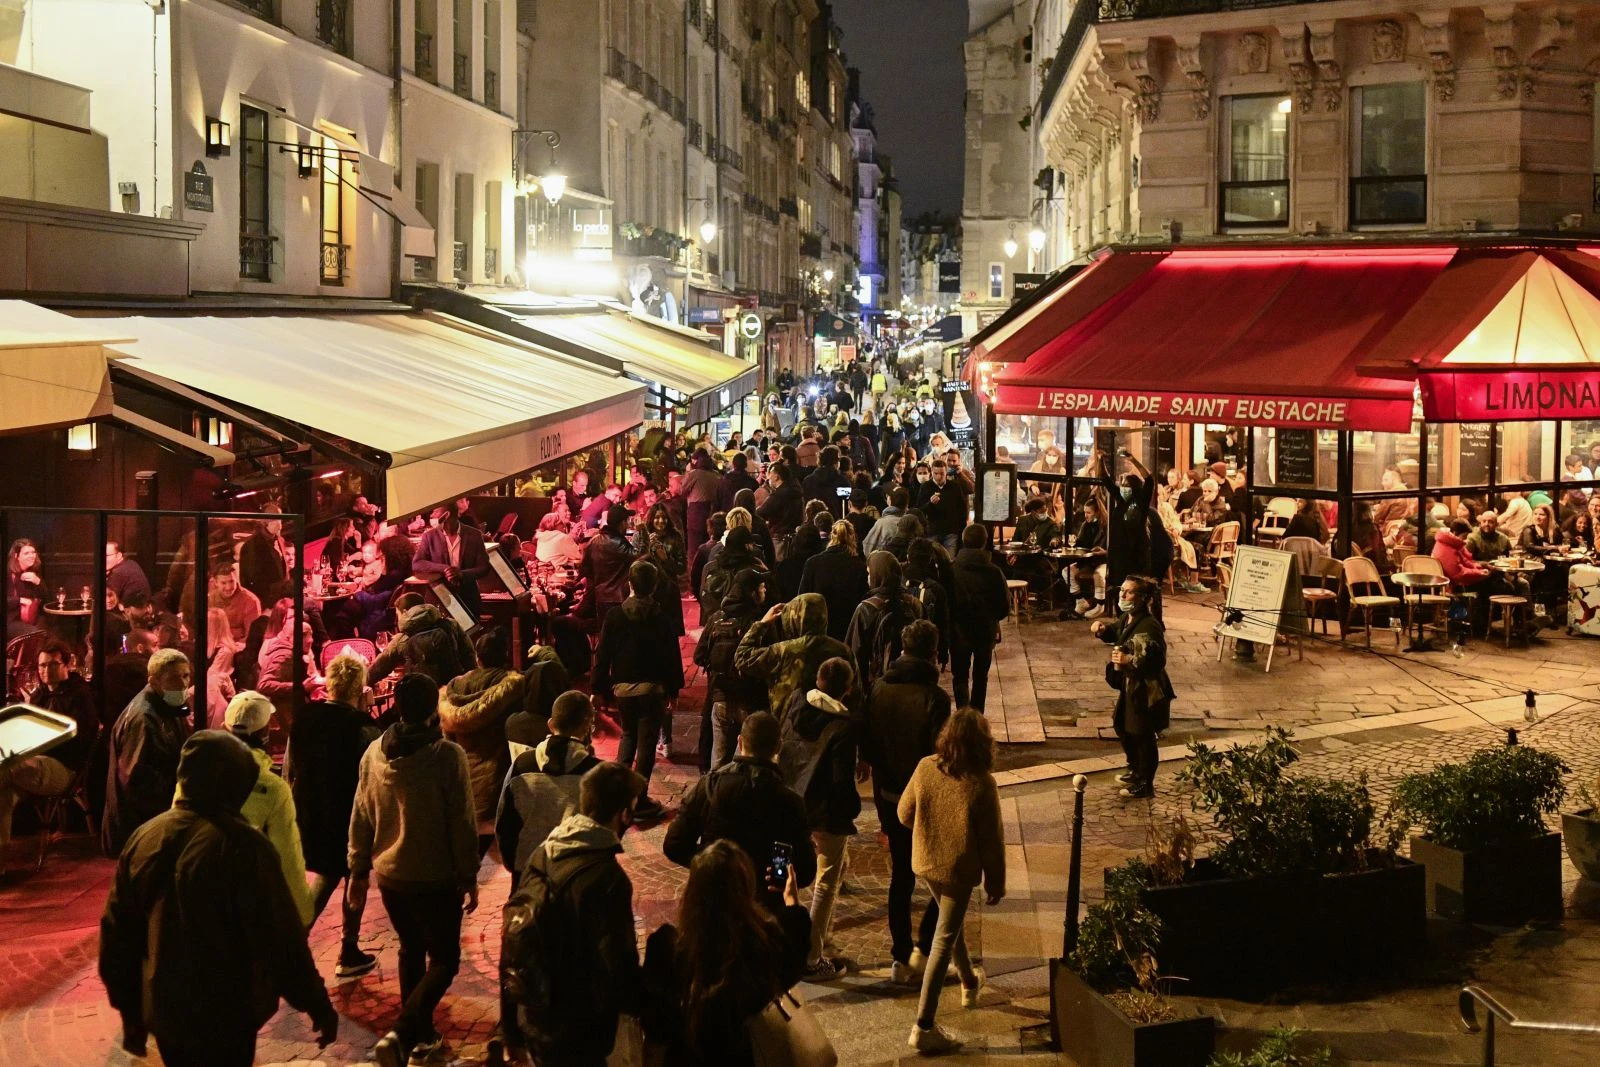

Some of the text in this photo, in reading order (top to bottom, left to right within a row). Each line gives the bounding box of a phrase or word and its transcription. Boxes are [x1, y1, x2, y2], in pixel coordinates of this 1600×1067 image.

[195, 181, 203, 191] RUE
[573, 209, 583, 232] la
[583, 209, 610, 246] perla
[1037, 391, 1347, 423] L'ESPLANADE SAINT EUSTACHE
[1486, 381, 1600, 410] LIMONA
